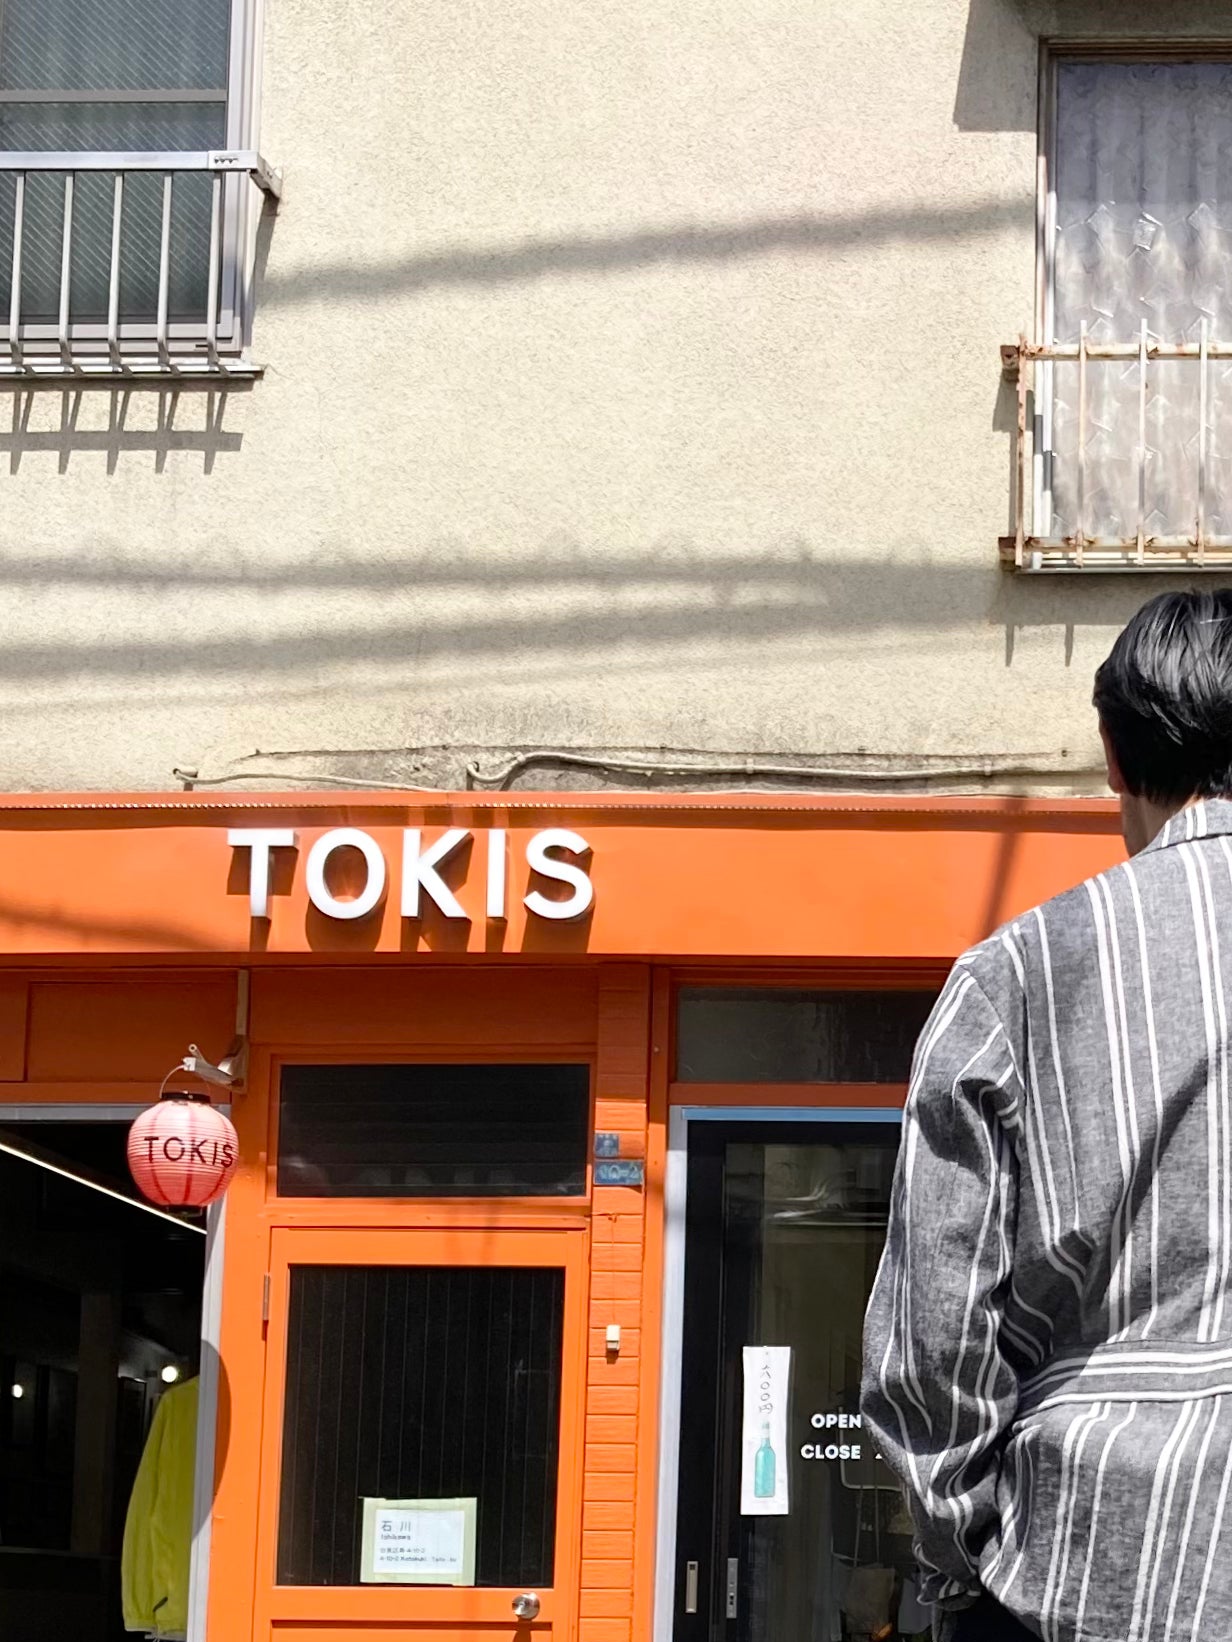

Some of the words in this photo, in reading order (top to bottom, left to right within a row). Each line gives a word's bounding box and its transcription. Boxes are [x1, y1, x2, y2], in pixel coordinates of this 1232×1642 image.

[227, 827, 593, 920] TOKIS
[144, 1136, 234, 1168] TOKIS
[811, 1413, 862, 1429] OPEN
[800, 1444, 861, 1460] CLOSE
